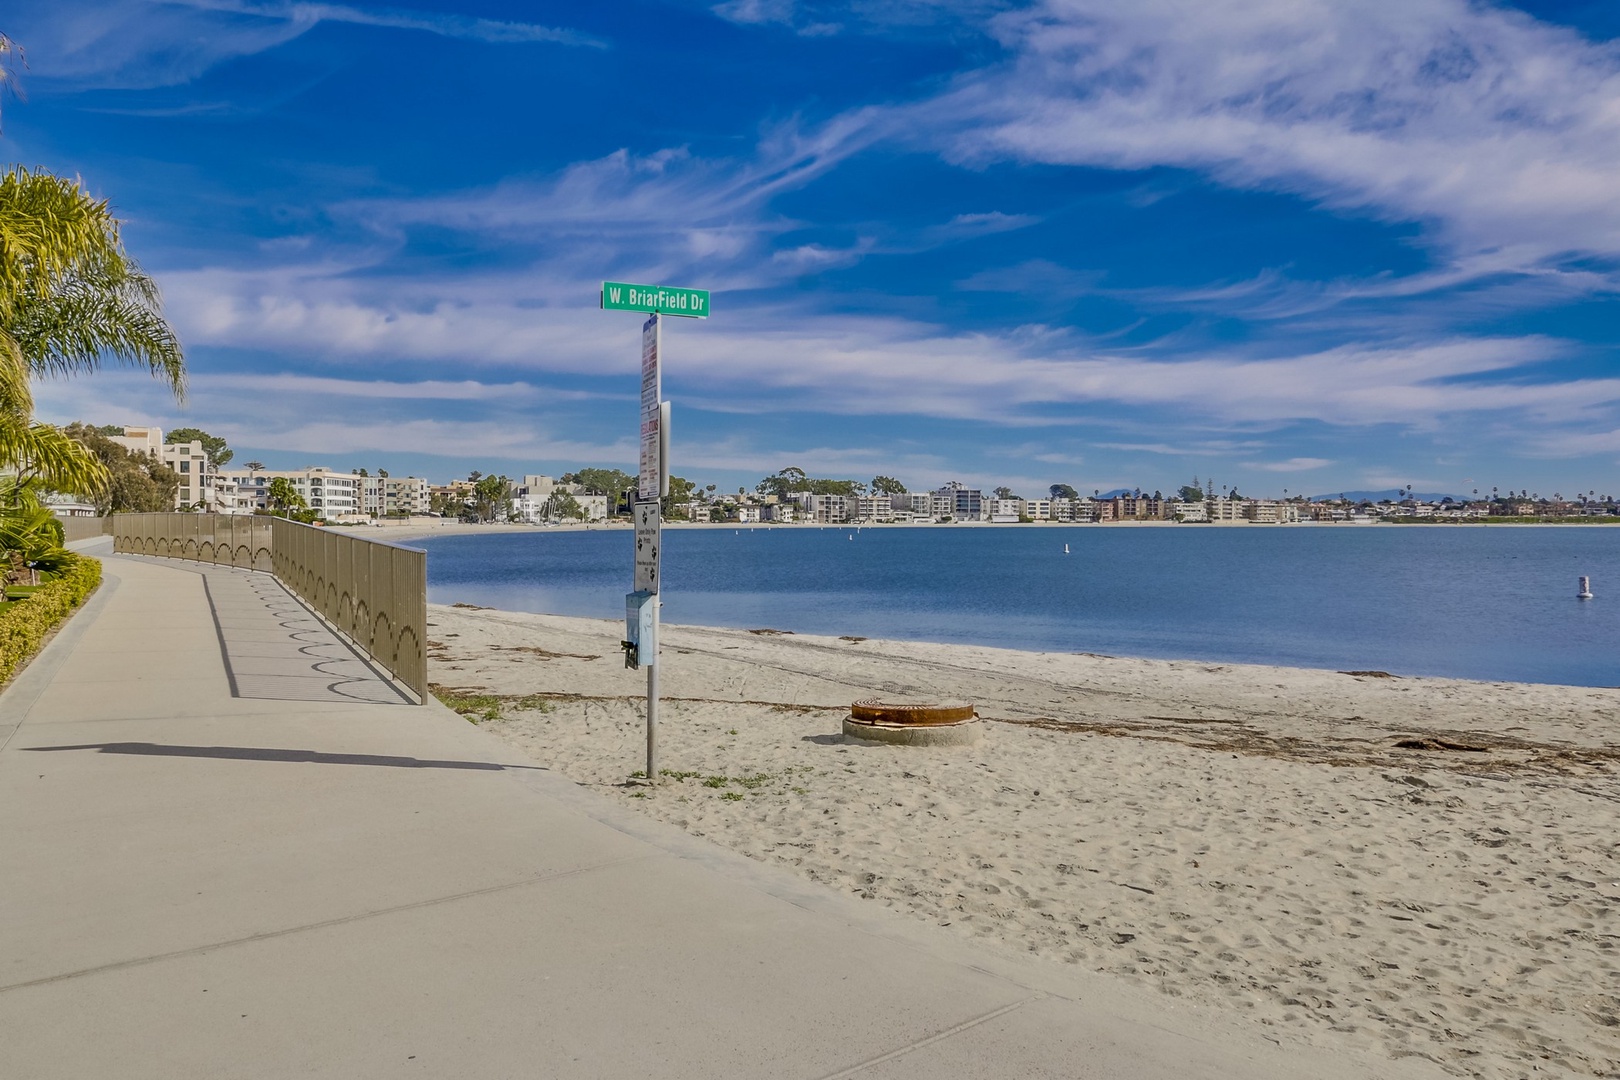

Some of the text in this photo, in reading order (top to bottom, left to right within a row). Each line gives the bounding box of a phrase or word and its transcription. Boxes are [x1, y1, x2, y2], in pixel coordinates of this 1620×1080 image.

[609, 287, 704, 310] W. BriarField Dr
